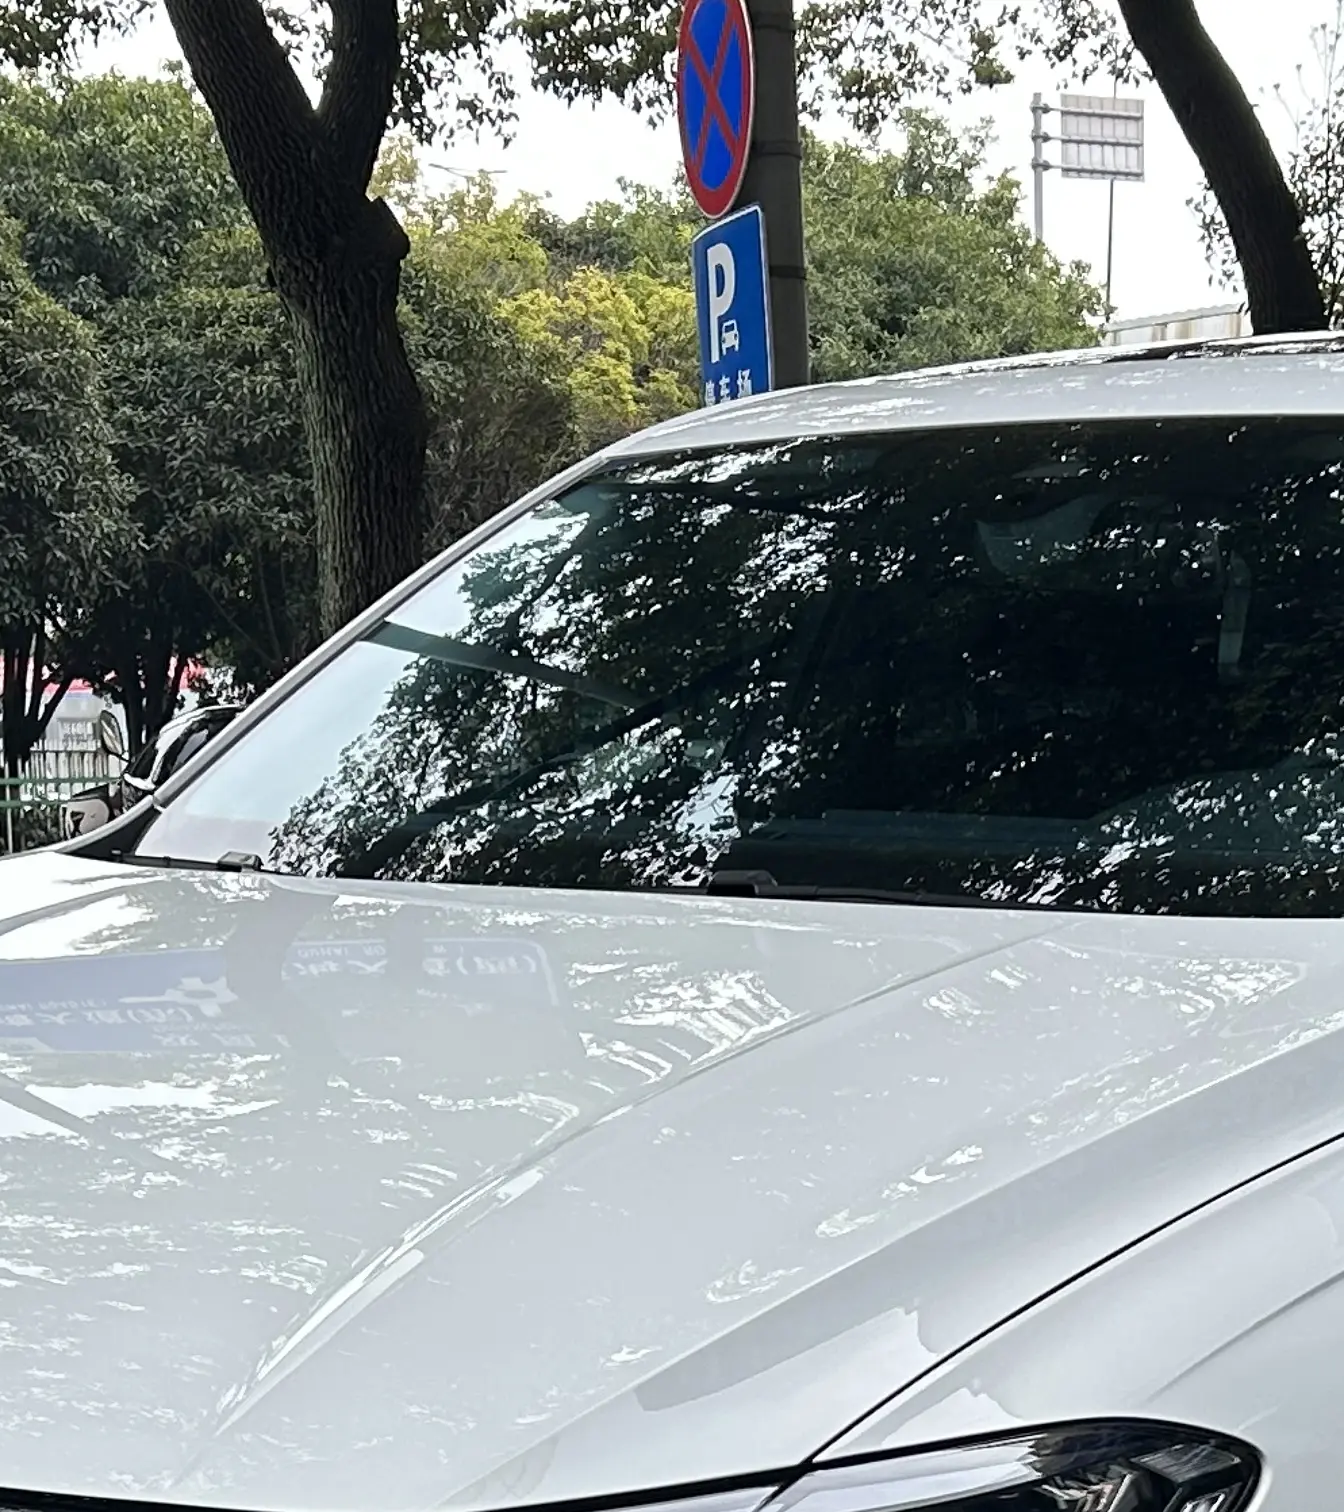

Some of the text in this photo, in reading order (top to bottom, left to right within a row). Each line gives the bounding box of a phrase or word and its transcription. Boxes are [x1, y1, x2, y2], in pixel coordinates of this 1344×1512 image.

[707, 242, 737, 364] P
[704, 368, 753, 407] 停车场
